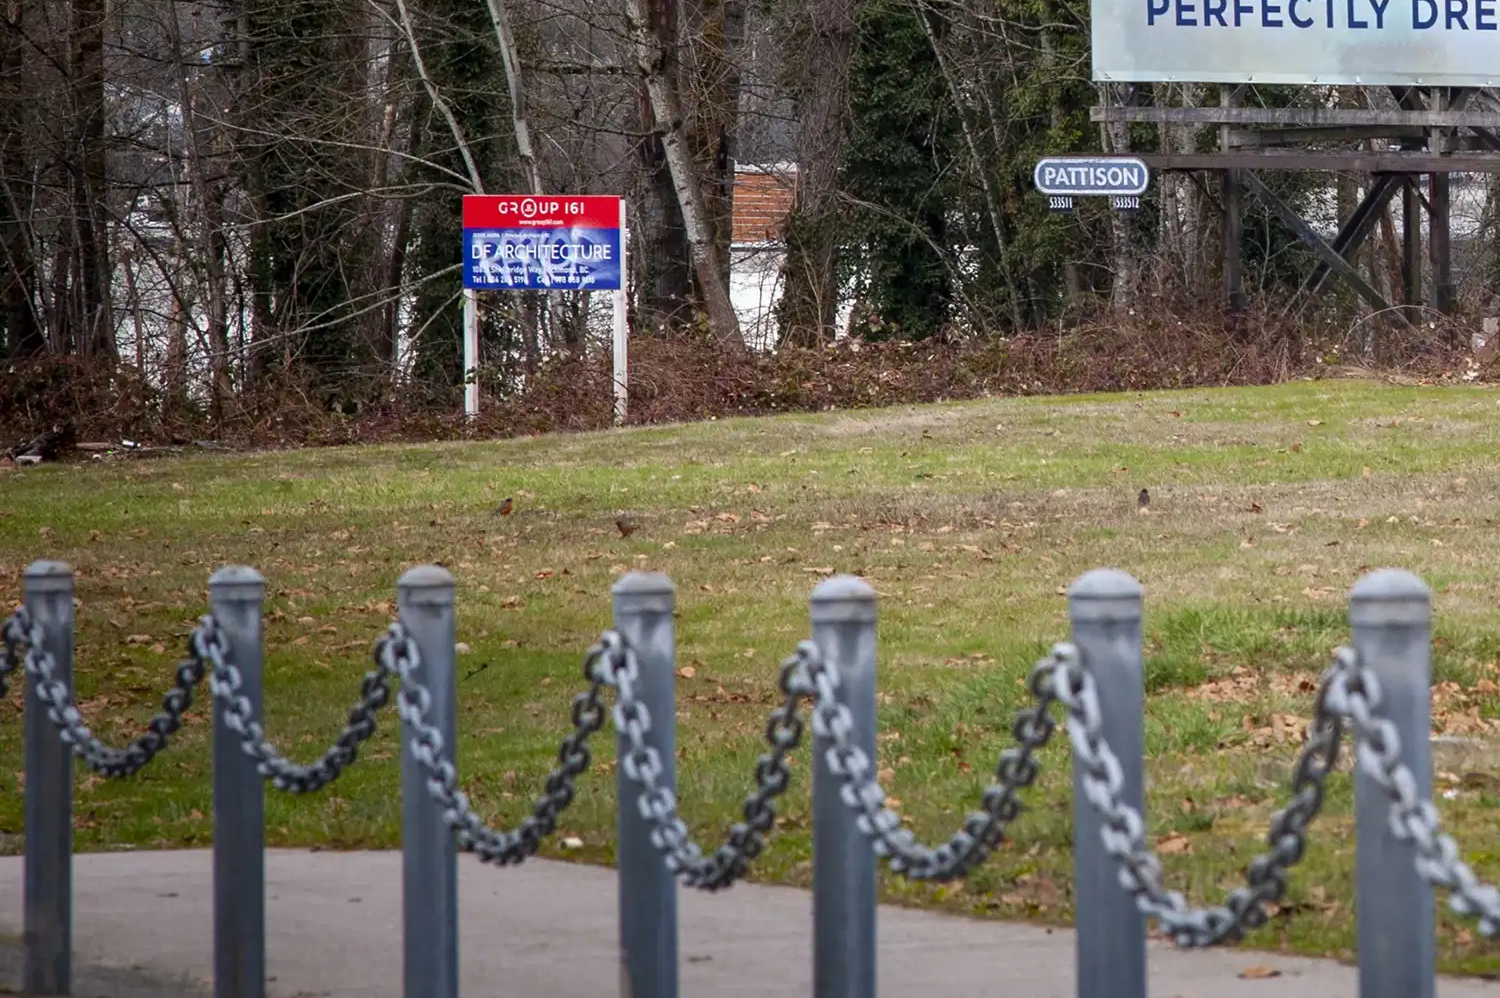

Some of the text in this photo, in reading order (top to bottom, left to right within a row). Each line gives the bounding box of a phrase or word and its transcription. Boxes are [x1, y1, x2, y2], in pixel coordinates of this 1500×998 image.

[1044, 166, 1139, 187] PATTISON
[498, 198, 585, 218] GROUP 161
[471, 244, 612, 260] DF ARCHITECTURE
[472, 275, 483, 284] Tel
